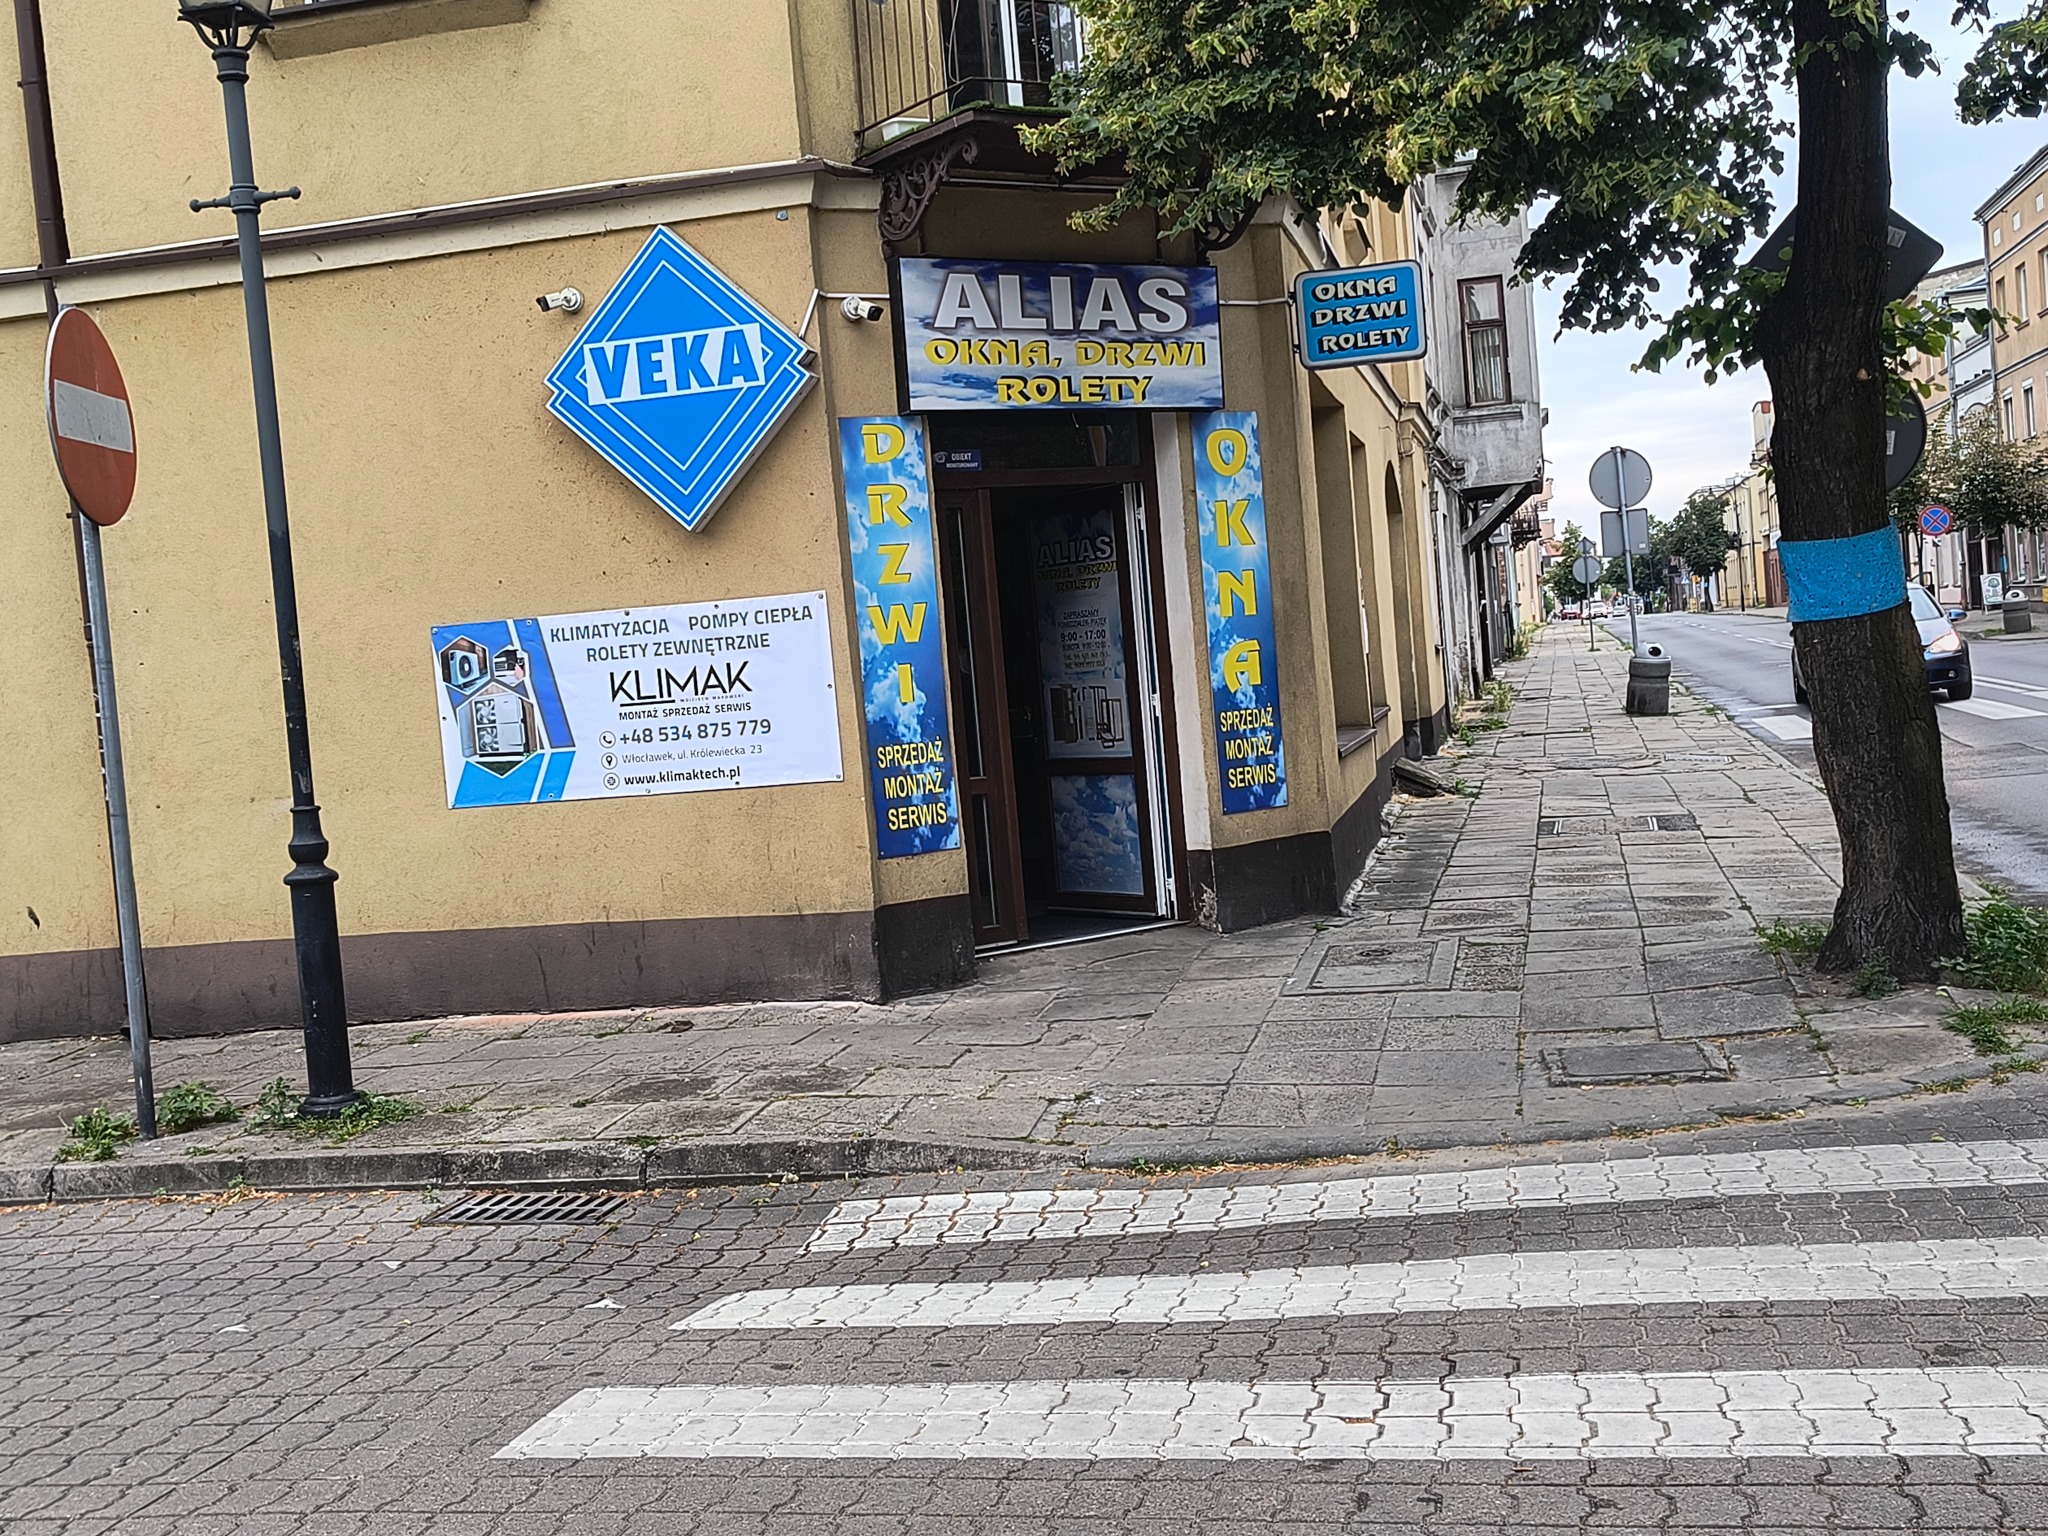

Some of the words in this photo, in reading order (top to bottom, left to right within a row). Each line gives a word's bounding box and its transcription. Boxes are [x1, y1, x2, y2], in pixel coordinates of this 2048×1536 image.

[933, 273, 1187, 332] ALIAS
[1313, 275, 1396, 302] OKNA
[1312, 300, 1407, 327] DRZWI
[923, 339, 1061, 368] OKNA,
[1075, 342, 1206, 368] DRZWI
[1319, 326, 1411, 354] ROLETY
[588, 328, 760, 400] VEKA
[996, 375, 1153, 405] ROLETY
[951, 452, 972, 461] OBIEKT
[861, 423, 927, 703] DRZWI
[1038, 536, 1112, 567] ALIAS
[1206, 428, 1262, 693] OKNA
[1056, 577, 1101, 593] ROLETY
[550, 618, 670, 643] KLIMATYZACJA
[688, 611, 749, 631] POMPY
[754, 605, 813, 625] CIEPŁA
[1060, 630, 1077, 642] 9:00
[1084, 629, 1106, 640] 17:00
[586, 643, 648, 662] ROLETY
[653, 632, 770, 657] ZEWNĘTRZNE
[609, 661, 753, 702] KLIMAK
[619, 707, 658, 721] MONTAŻ
[663, 703, 711, 718] SPRZEDAŻ
[715, 702, 751, 713] SERWIS
[1220, 702, 1274, 732] SPRZEDAŻ
[619, 728, 654, 744] +48
[658, 725, 692, 742] 534
[697, 722, 732, 739] 875
[737, 718, 771, 736] 779
[622, 753, 676, 764] Włocławek,
[677, 750, 689, 760] ul.
[690, 746, 746, 758] Królewiecka
[750, 745, 763, 754] 23
[877, 736, 944, 769] SPRZEDAŻ
[1225, 732, 1274, 760] MONTAŻ
[624, 766, 741, 785] www.klimaktech.pl
[884, 767, 944, 799] MONTAŻ
[1228, 764, 1276, 789] SERWIS
[888, 802, 947, 830] SERWIS
